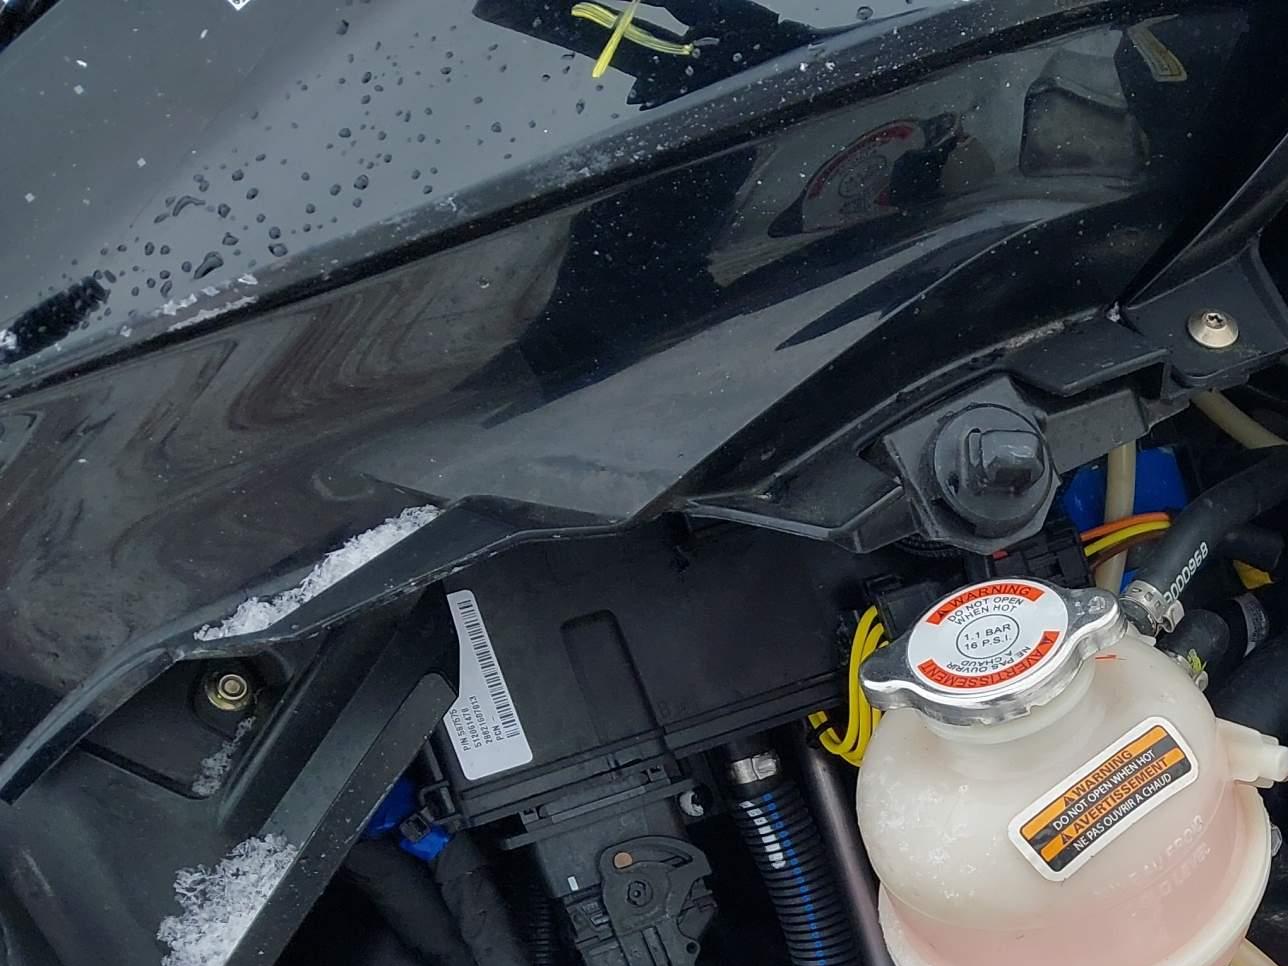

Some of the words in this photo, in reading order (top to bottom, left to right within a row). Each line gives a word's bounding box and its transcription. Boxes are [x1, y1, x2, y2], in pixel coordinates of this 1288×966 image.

[952, 583, 1031, 607] WARNING
[948, 608, 963, 622] DO
[966, 598, 989, 611] NOT
[993, 596, 1024, 606] OPEN
[954, 606, 990, 626] WHEN
[993, 604, 1017, 613] HOT
[964, 631, 981, 641] 1.1
[985, 623, 1012, 636] BAR
[965, 641, 978, 650] 16
[982, 636, 1013, 647] P.S.I.
[960, 656, 1003, 667] CHAUD
[991, 656, 1014, 671] PAS
[1014, 646, 1032, 658] NE
[919, 648, 1045, 689] AVERTISSEMENT
[946, 661, 988, 673] OUVRIR
[1071, 750, 1133, 796] WARNING
[1052, 814, 1070, 831] DO
[1067, 798, 1087, 818] NOT
[1087, 780, 1113, 803] OPEN
[1109, 761, 1139, 785] WHEN
[1136, 749, 1155, 767] HOT
[1073, 757, 1170, 834] AVERTISSEMENT
[1073, 834, 1090, 852] NE
[1088, 822, 1105, 840] PAS
[1103, 797, 1137, 827] OUVRIR
[1135, 793, 1144, 804] A
[1142, 773, 1172, 798] CHAUD
